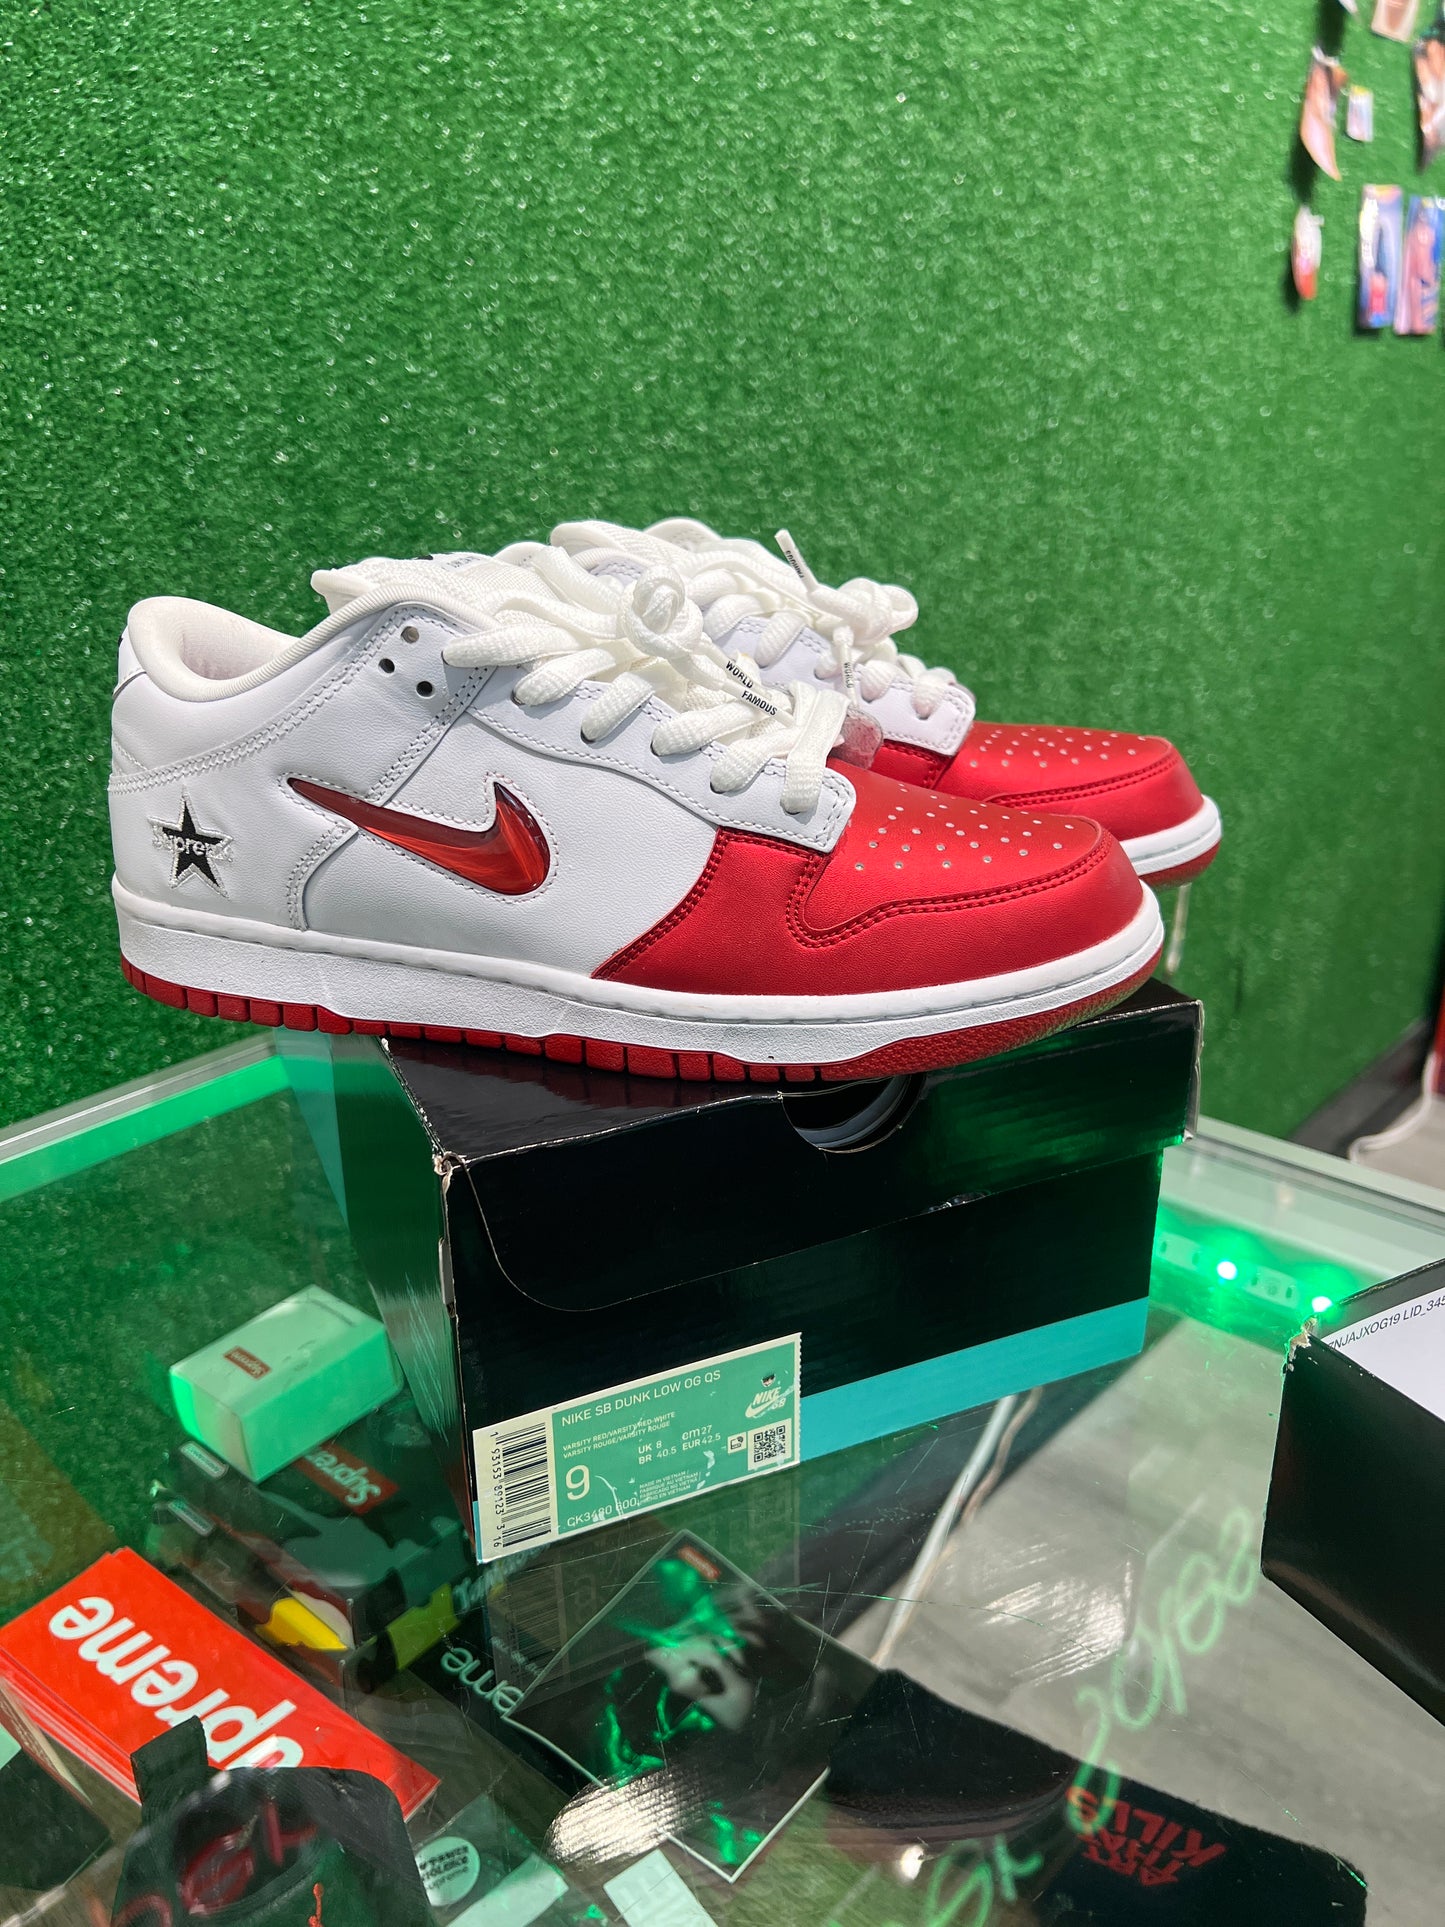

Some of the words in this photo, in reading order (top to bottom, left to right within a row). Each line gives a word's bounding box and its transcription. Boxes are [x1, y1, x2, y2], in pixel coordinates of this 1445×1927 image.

[726, 661, 754, 689] WORLD
[741, 691, 778, 716] FAMOUS
[562, 1408, 592, 1427] NIKE
[595, 1402, 612, 1416] SB
[615, 1391, 651, 1410] DUNK
[654, 1381, 681, 1398] LOW
[684, 1375, 701, 1389] OG
[704, 1370, 721, 1383] QS
[753, 1386, 781, 1406] NIKE
[682, 1428, 700, 1441] cm
[701, 1425, 712, 1435] 27
[682, 1439, 700, 1451] EUR
[702, 1434, 721, 1445] 42.5
[563, 1438, 591, 1451] VARSITY
[563, 1446, 591, 1459] VARSITY
[638, 1443, 652, 1454] UK
[656, 1440, 662, 1449] 8
[491, 1448, 501, 1480] 93153
[639, 1454, 652, 1465] BR
[657, 1447, 677, 1459] 40.5
[565, 1464, 590, 1500] 9
[494, 1484, 504, 1515] 89123
